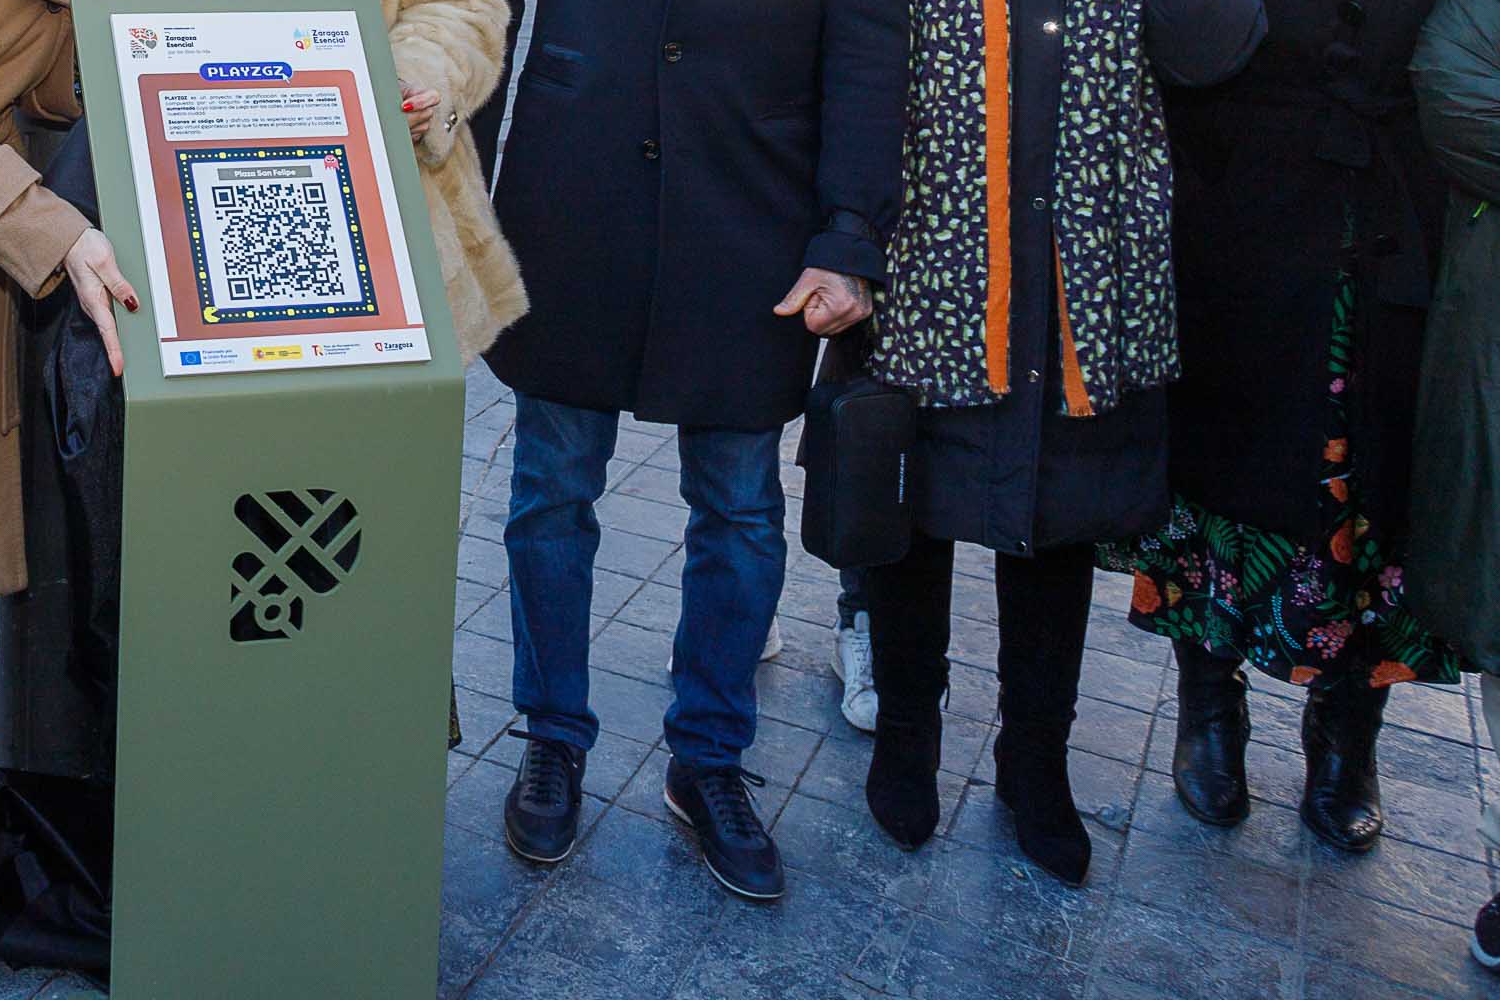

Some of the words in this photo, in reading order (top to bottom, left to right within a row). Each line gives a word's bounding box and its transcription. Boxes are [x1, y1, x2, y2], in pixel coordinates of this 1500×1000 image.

[311, 29, 349, 37] Zaragoza
[313, 36, 346, 44] Esencial
[207, 65, 284, 78] PLAYZGZ
[257, 169, 273, 177] San
[273, 168, 297, 177] Felipe
[383, 342, 413, 350] Zaragoza
